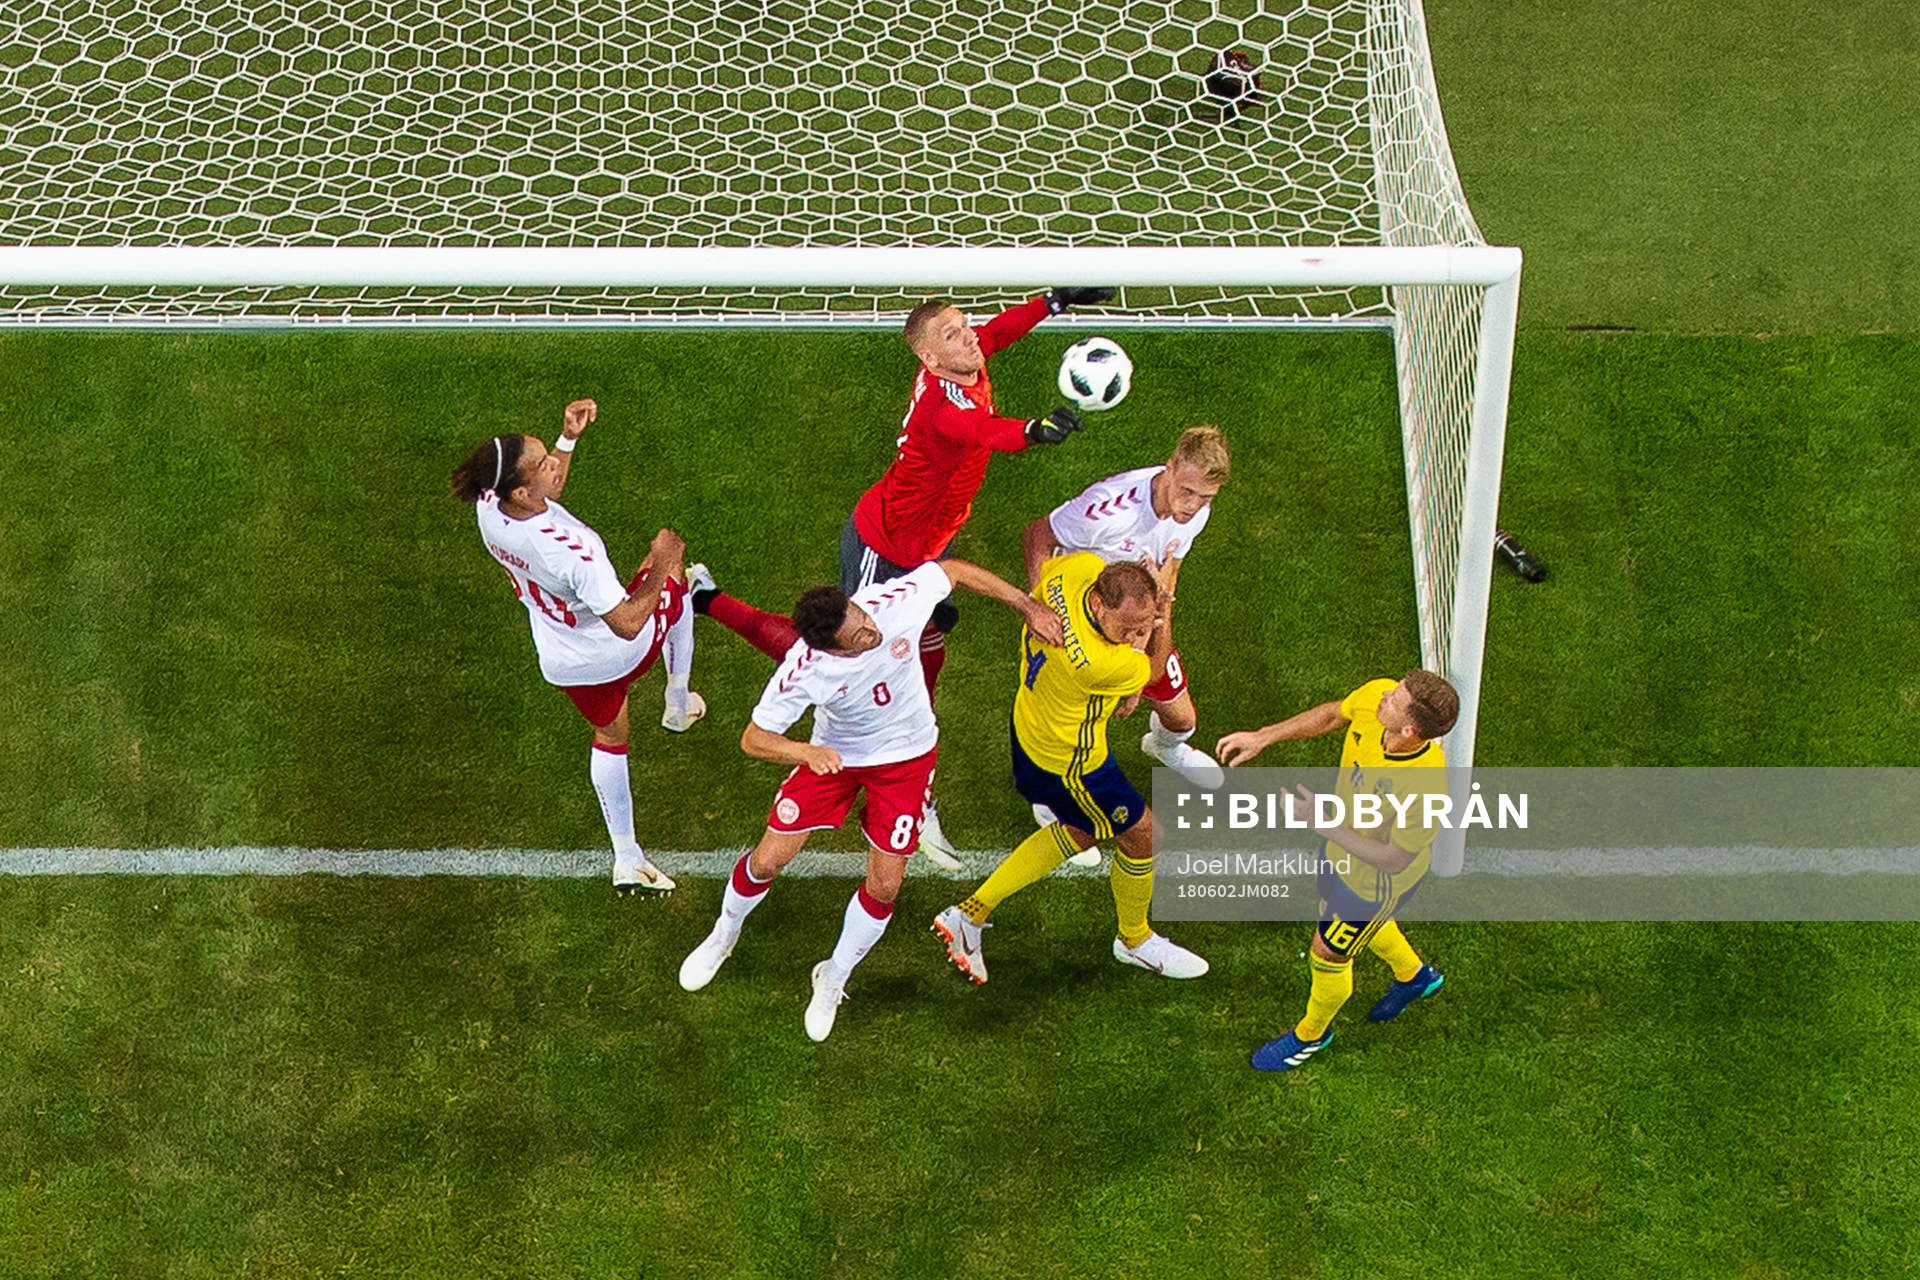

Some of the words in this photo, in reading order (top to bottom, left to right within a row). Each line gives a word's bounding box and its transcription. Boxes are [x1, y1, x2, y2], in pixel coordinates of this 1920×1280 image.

[1165, 652, 1184, 689] 9
[872, 681, 891, 707] 8
[889, 814, 914, 850] 8
[1324, 912, 1360, 950] 16
